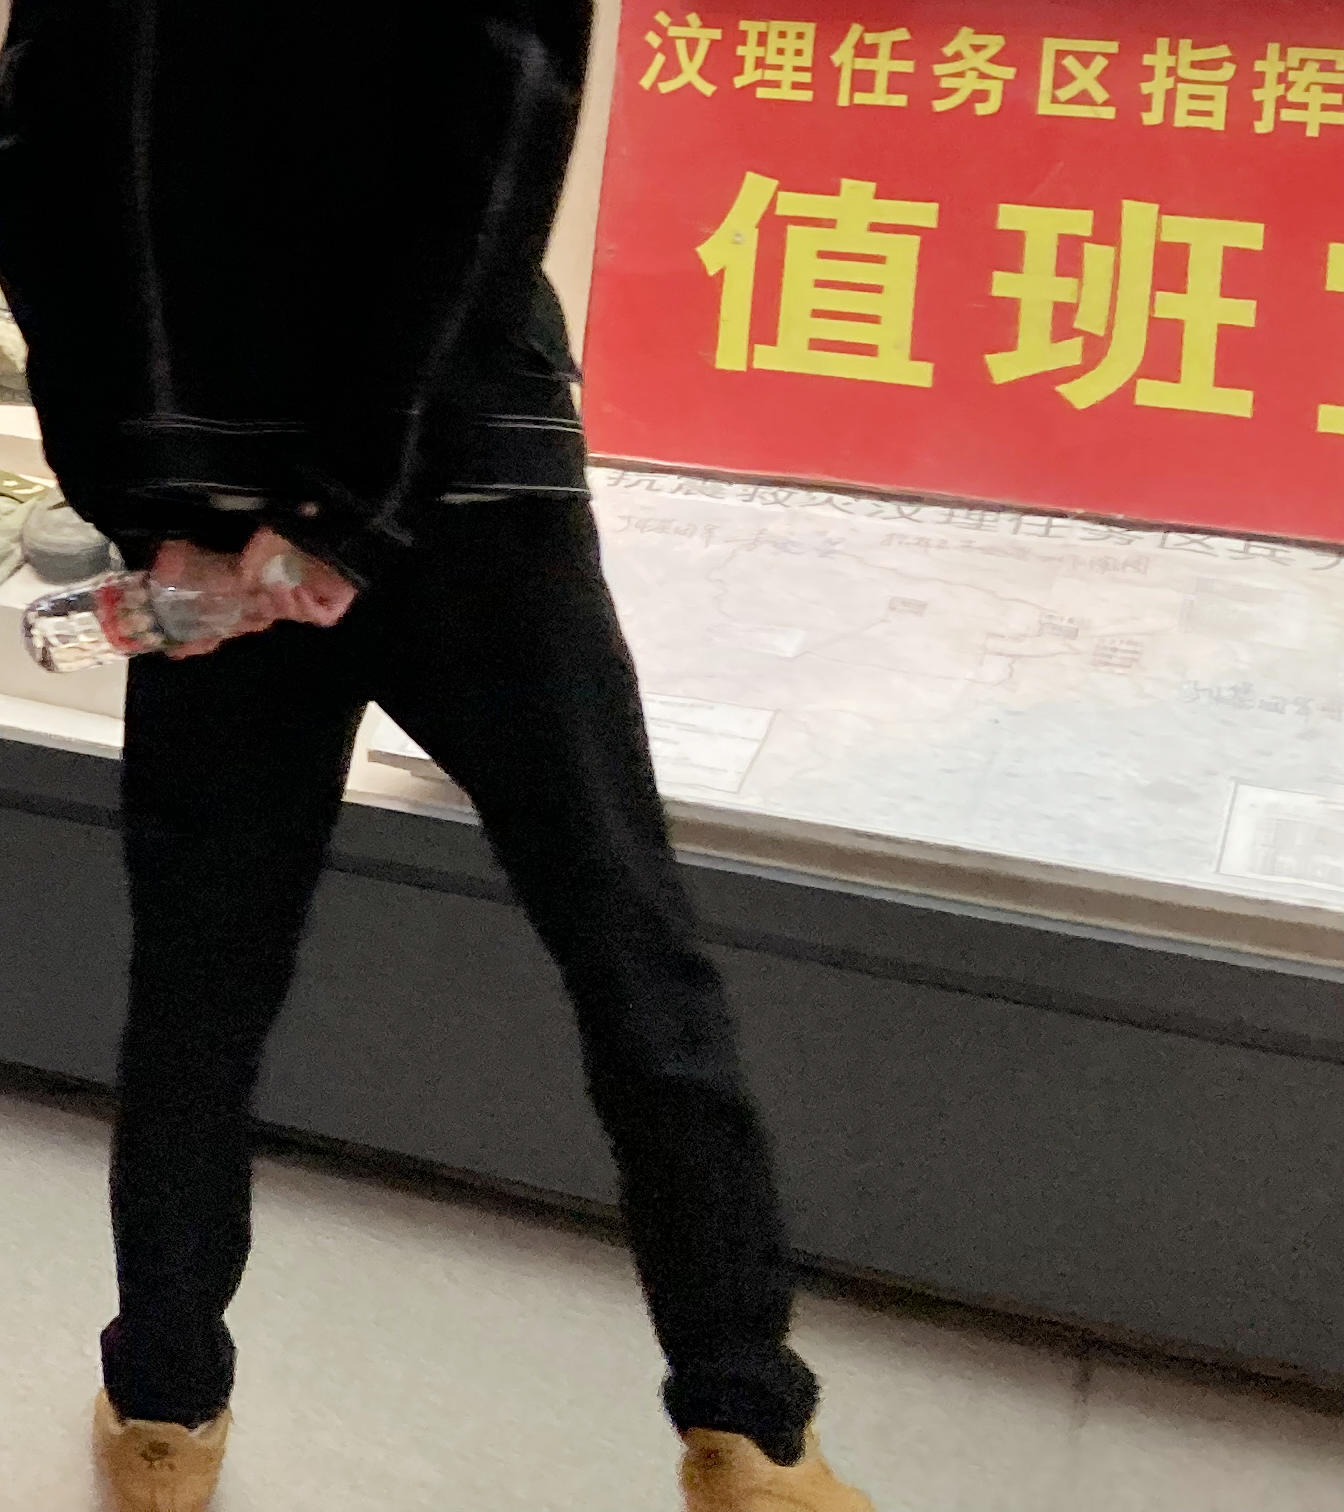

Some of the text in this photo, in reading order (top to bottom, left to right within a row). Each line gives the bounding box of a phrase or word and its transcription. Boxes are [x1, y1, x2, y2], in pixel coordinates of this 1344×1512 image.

[638, 9, 1344, 138] 汶理任务区指挥
[696, 170, 1344, 435] 值班
